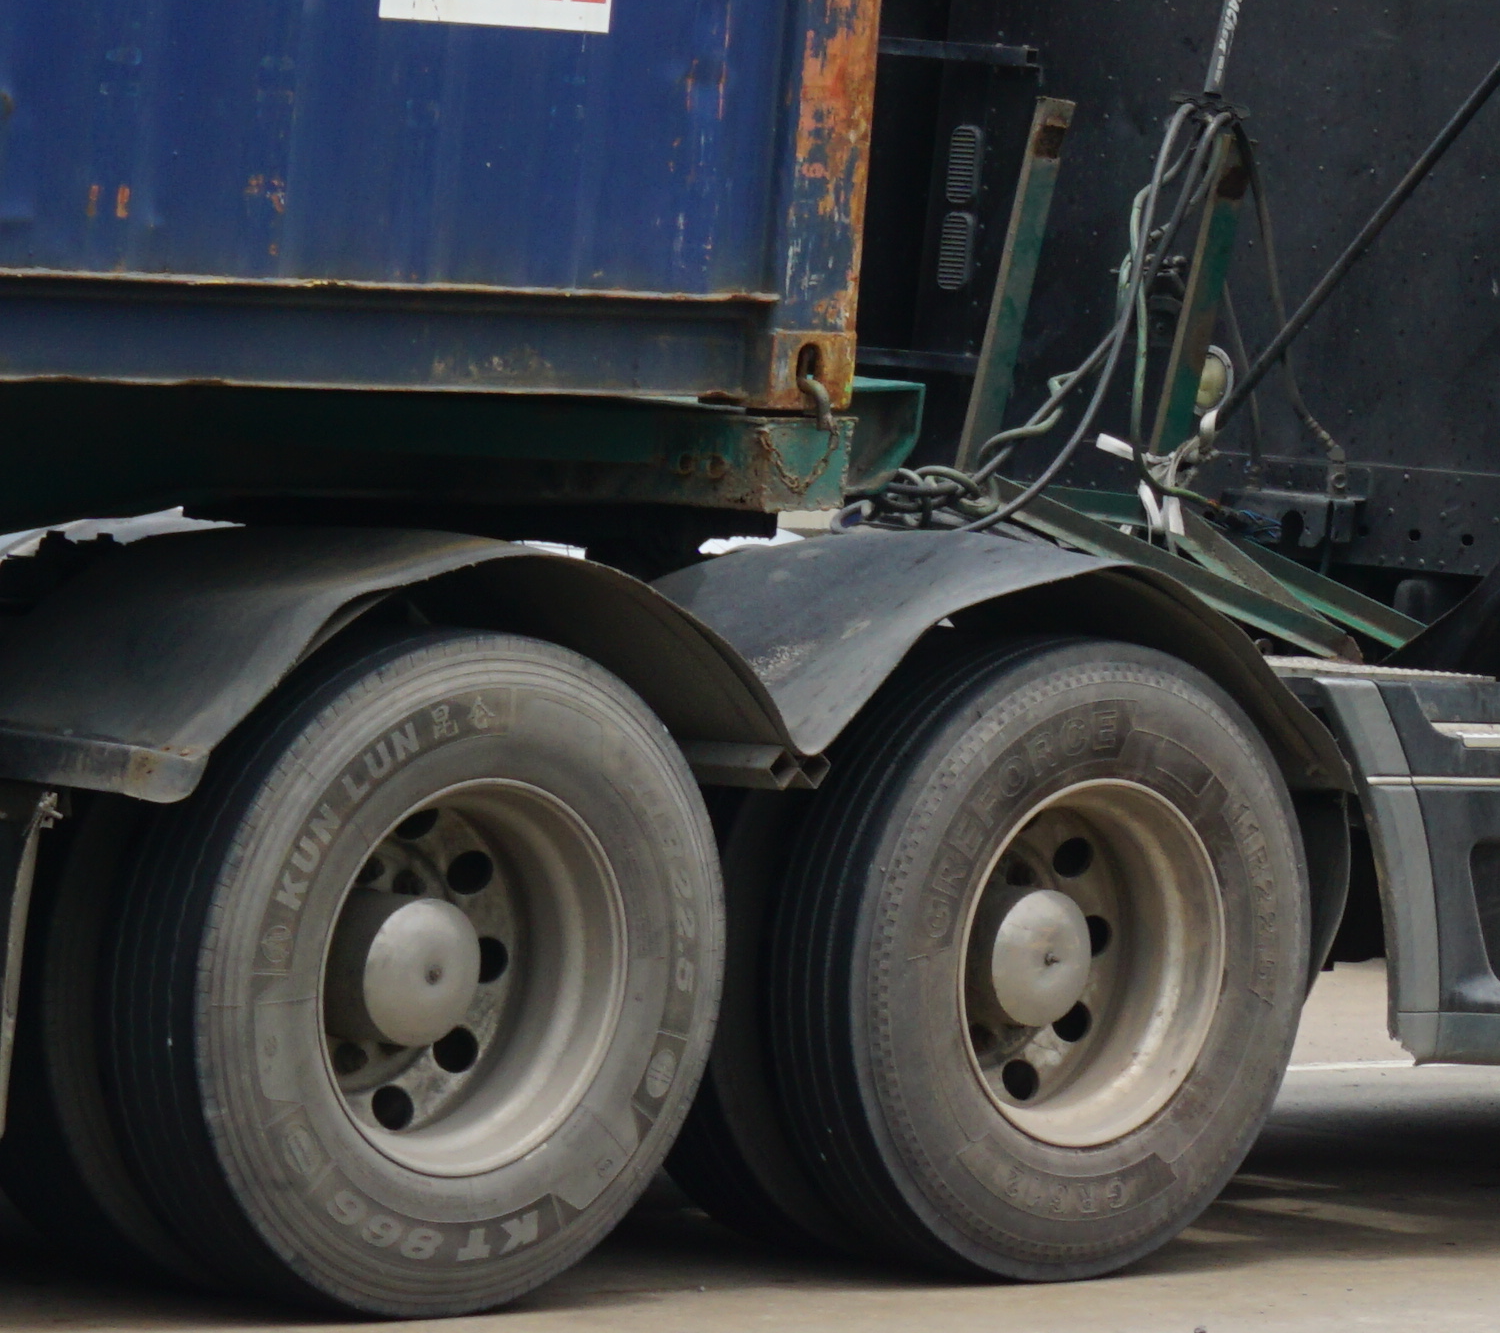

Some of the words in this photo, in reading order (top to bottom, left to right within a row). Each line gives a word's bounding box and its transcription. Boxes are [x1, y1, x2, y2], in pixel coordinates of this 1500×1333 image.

[276, 803, 348, 913] KUN
[340, 722, 422, 805] LUN
[324, 1191, 440, 1262] 866
[456, 1211, 541, 1263] KT
